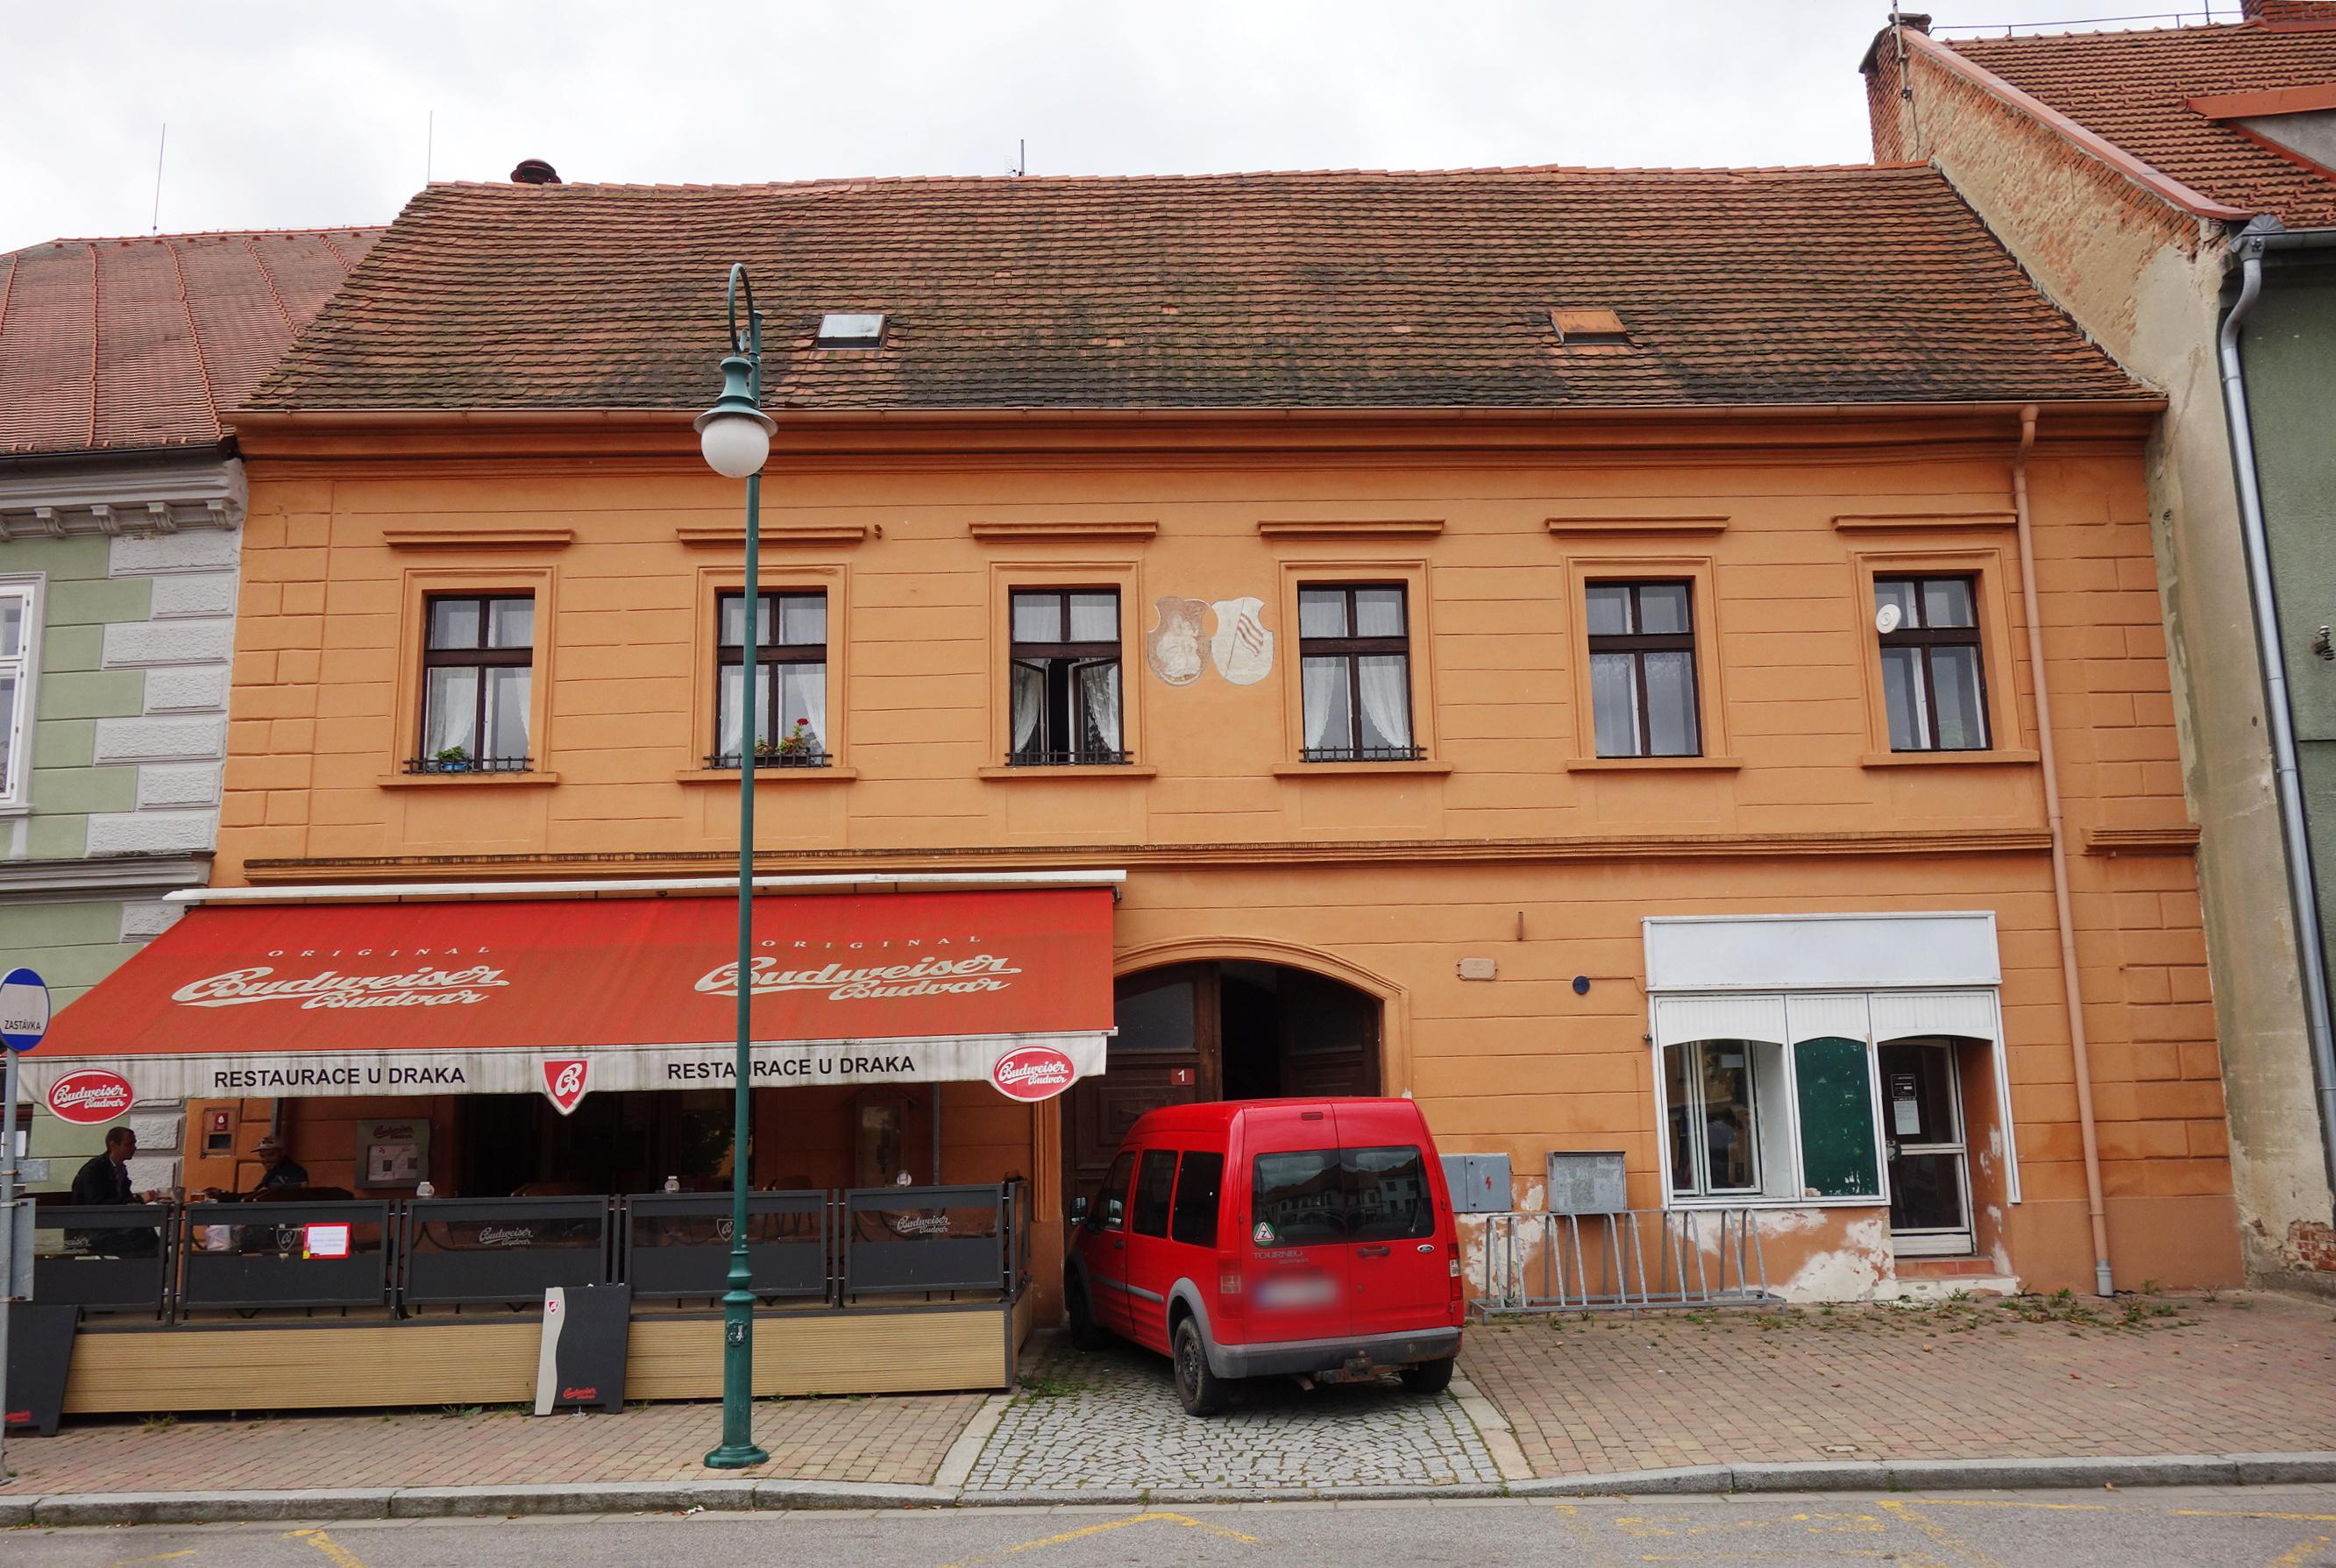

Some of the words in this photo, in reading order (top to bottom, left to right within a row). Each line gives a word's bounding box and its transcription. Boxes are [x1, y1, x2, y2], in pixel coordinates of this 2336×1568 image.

[761, 935, 981, 949] ORIGINAL
[267, 946, 492, 958] ORIGINAL
[694, 954, 1022, 994] Budweiser
[171, 965, 510, 1005] Budweiser
[827, 977, 1012, 1001] Budvar
[300, 990, 491, 1010] Budvar
[4, 1019, 41, 1031] ZASTÁVKA
[667, 1059, 812, 1080] RESTARACE
[819, 1058, 832, 1075] U
[840, 1056, 915, 1074] DRAKA
[998, 1061, 1069, 1082] Budweiser
[1177, 1069, 1185, 1082] 1
[214, 1068, 360, 1088] RESTAURACE
[367, 1068, 381, 1084] U
[388, 1067, 465, 1084] DRAKA
[1027, 1074, 1068, 1085] Budvar
[53, 1084, 128, 1106] Budweiser
[83, 1097, 126, 1109] Budvar
[897, 1215, 951, 1231] Budweiser
[479, 1226, 534, 1243] Budweiser
[1261, 1230, 1267, 1238] Z
